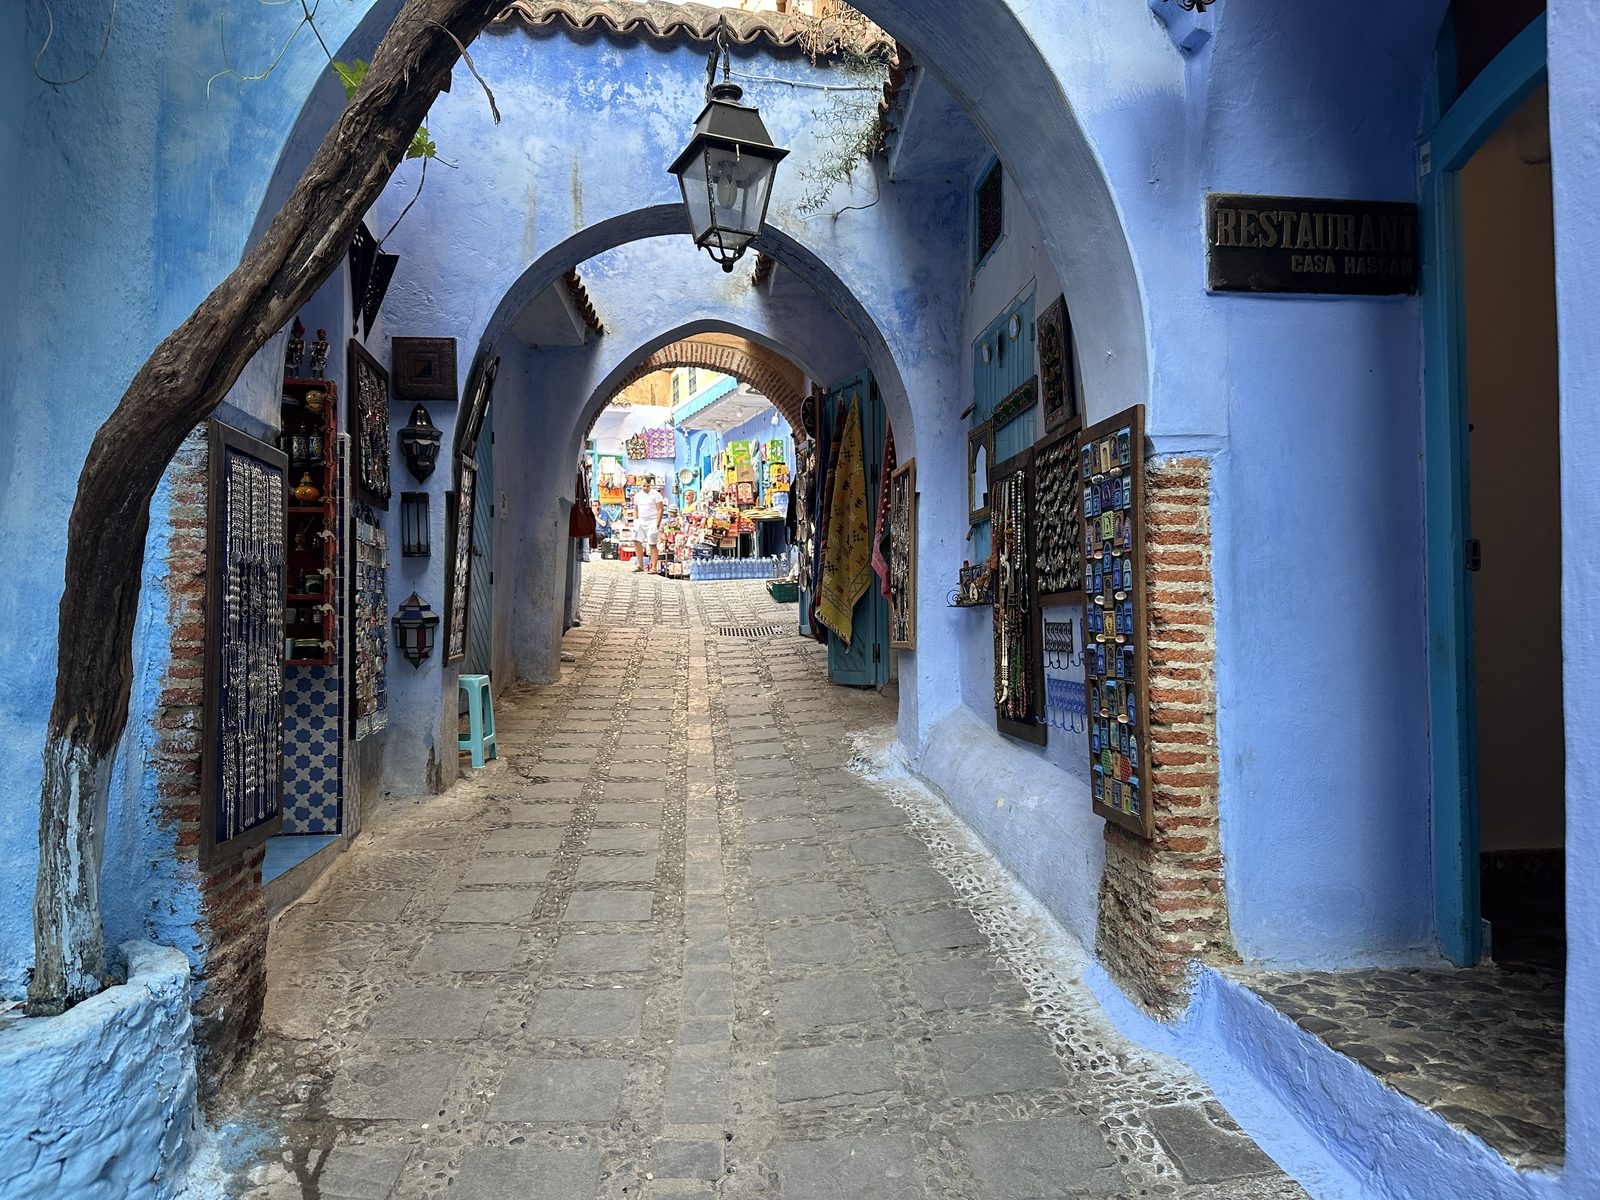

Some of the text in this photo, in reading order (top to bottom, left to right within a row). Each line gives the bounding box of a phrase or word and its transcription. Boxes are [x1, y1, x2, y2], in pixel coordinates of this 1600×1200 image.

[1215, 208, 1415, 252] RESTAURANT
[1291, 255, 1413, 276] CASA HASSAN
